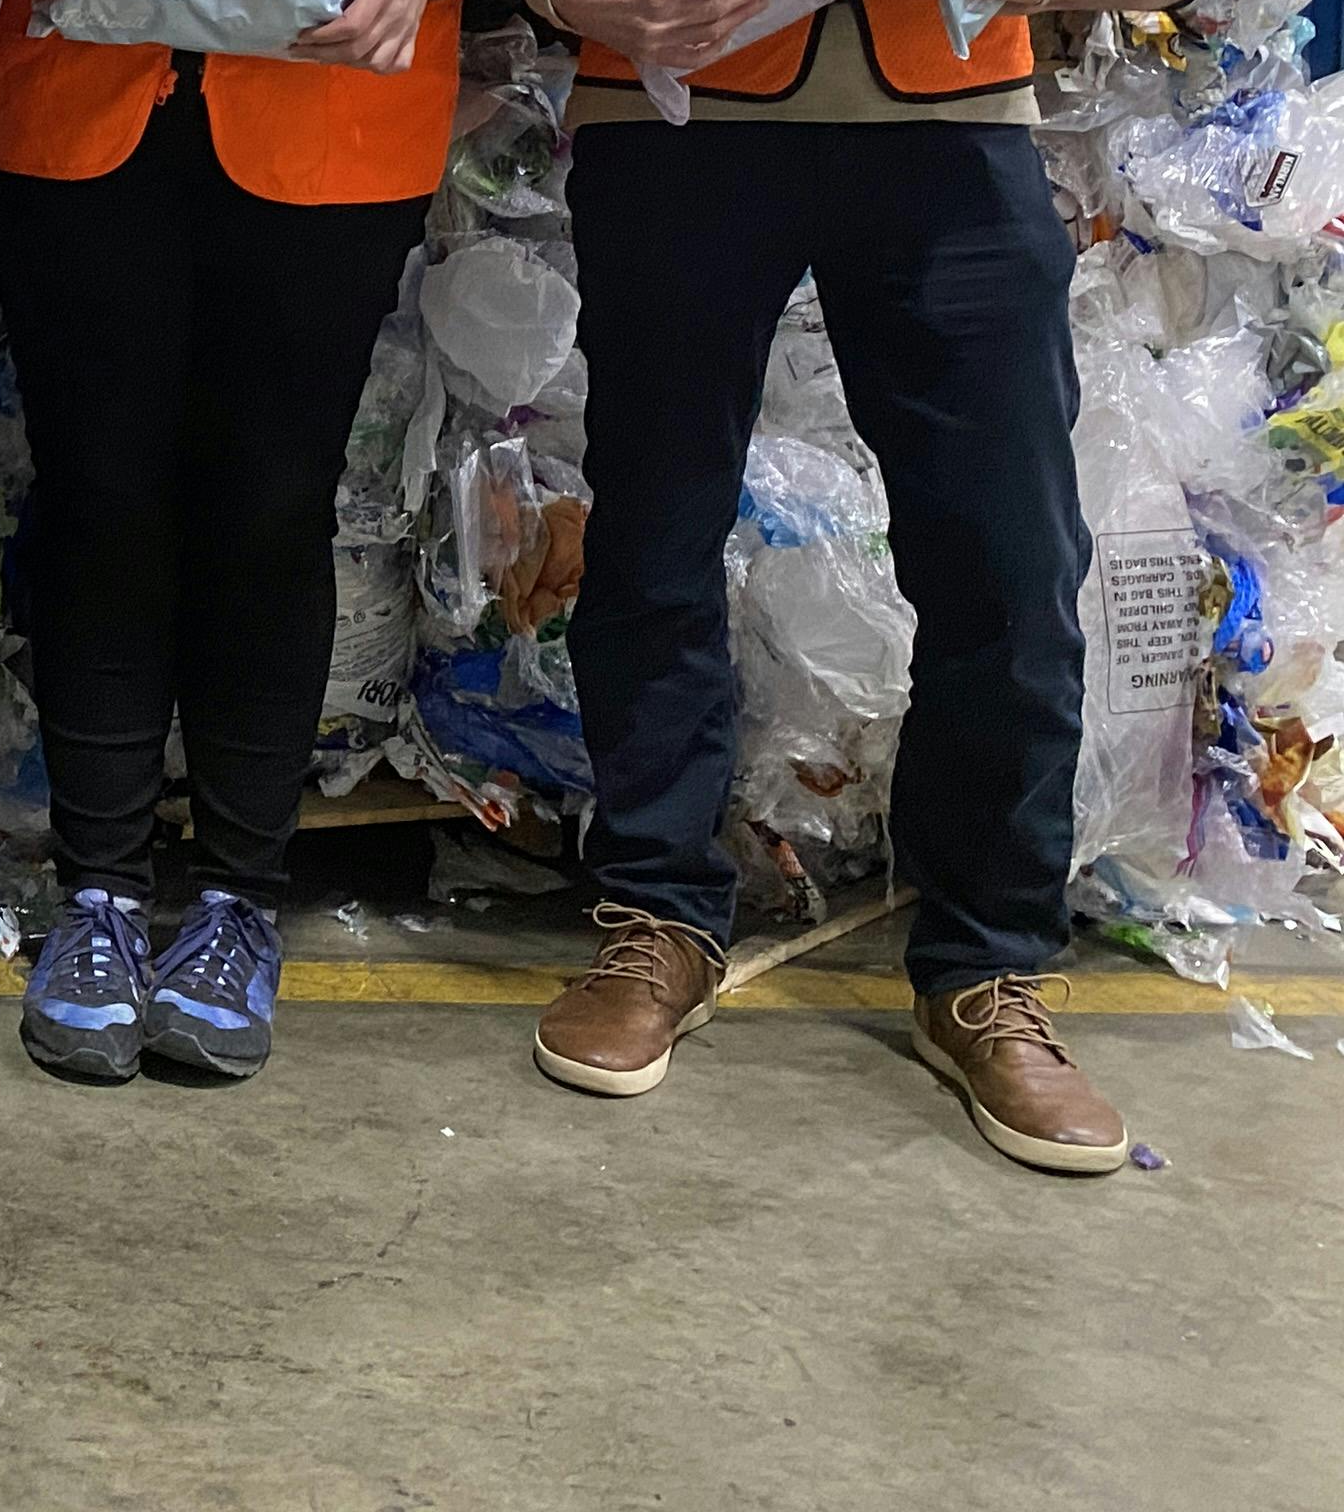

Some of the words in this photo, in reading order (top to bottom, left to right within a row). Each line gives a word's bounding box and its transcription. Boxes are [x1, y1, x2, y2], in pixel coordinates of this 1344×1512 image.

[1109, 560, 1123, 571] IS
[1125, 558, 1148, 570] BAG
[1148, 557, 1173, 569] THIS
[1111, 571, 1175, 587] CARRIAGES
[1113, 591, 1127, 603] IN
[1130, 588, 1154, 600] BAG
[1157, 586, 1183, 598] THIS
[1116, 619, 1148, 634] FROM
[1151, 617, 1183, 631] AWAY
[1116, 638, 1140, 650] THIS
[1148, 636, 1173, 647] KEEP
[1116, 653, 1130, 666] OF
